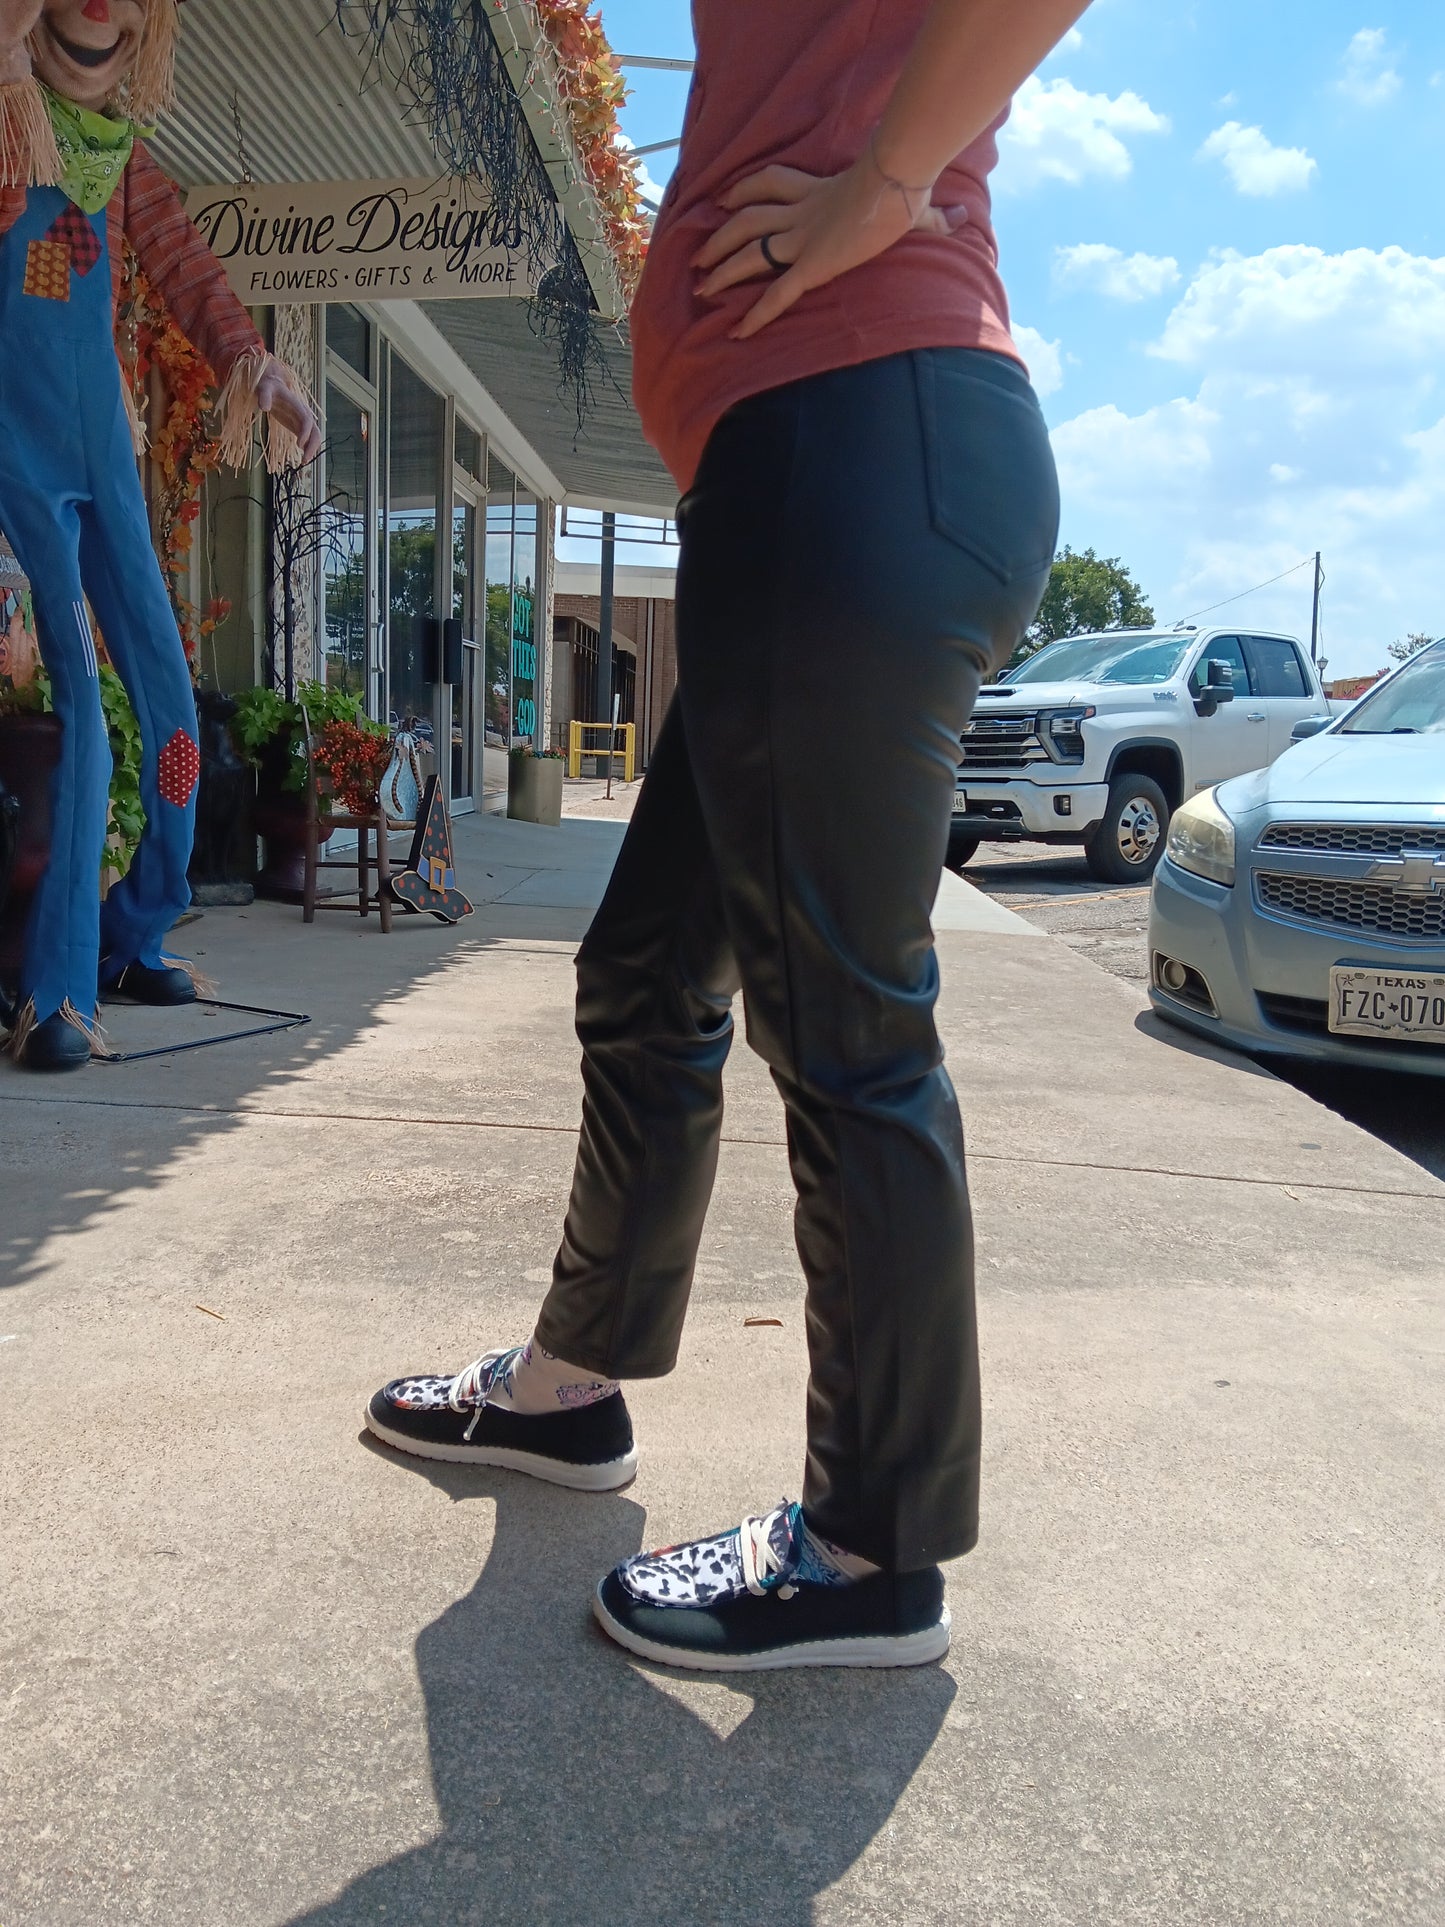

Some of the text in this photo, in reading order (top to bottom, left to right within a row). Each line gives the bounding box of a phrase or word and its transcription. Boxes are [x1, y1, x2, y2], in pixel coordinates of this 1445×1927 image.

[193, 187, 523, 272] Divine Designs
[250, 262, 519, 291] FLOWERS GIFTS & MORE
[512, 639, 537, 681] THIS
[1376, 976, 1427, 990] TEXAS
